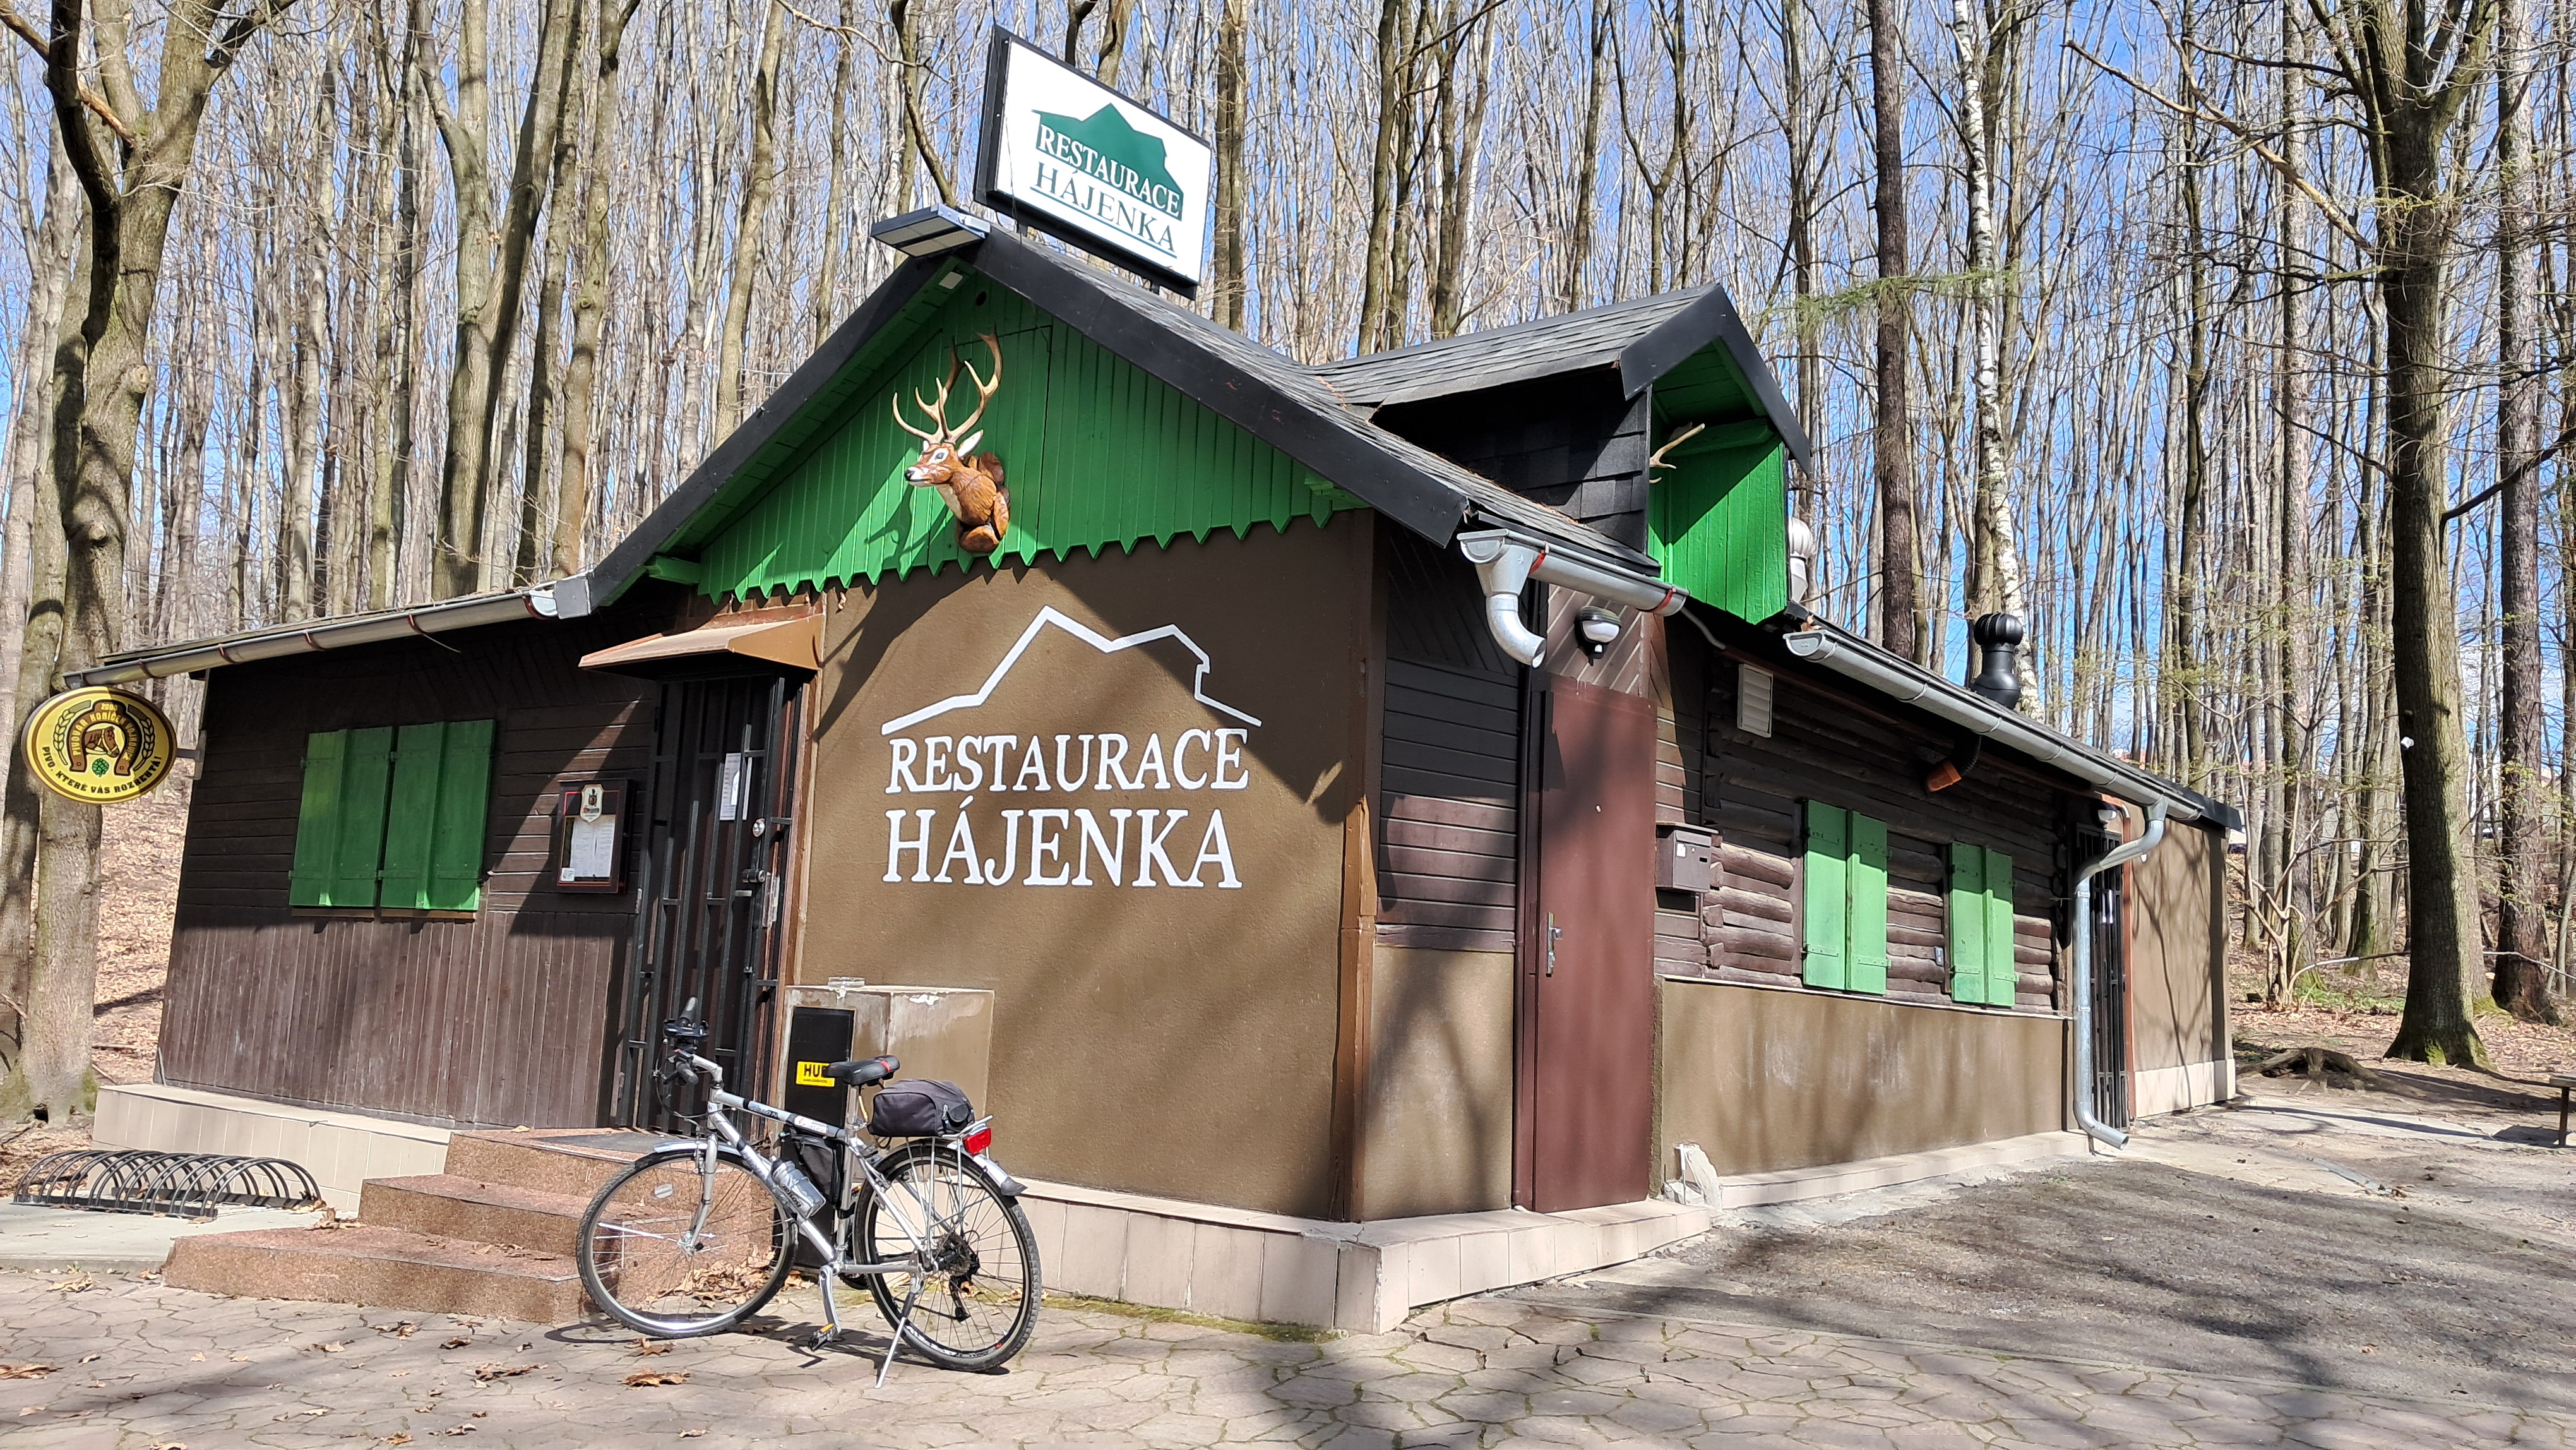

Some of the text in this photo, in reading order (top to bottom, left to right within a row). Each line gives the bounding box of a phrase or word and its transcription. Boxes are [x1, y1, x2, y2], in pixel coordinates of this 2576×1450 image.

[1035, 161, 1176, 252] HÁJENKA
[1038, 124, 1181, 217] RESTAURACE
[71, 719, 88, 756] PIVOVAR
[885, 728, 1249, 794] RESTAURACE
[56, 770, 88, 792] KTERÉ
[90, 785, 110, 794] VÁS
[883, 795, 1243, 888] HÁJENKA
